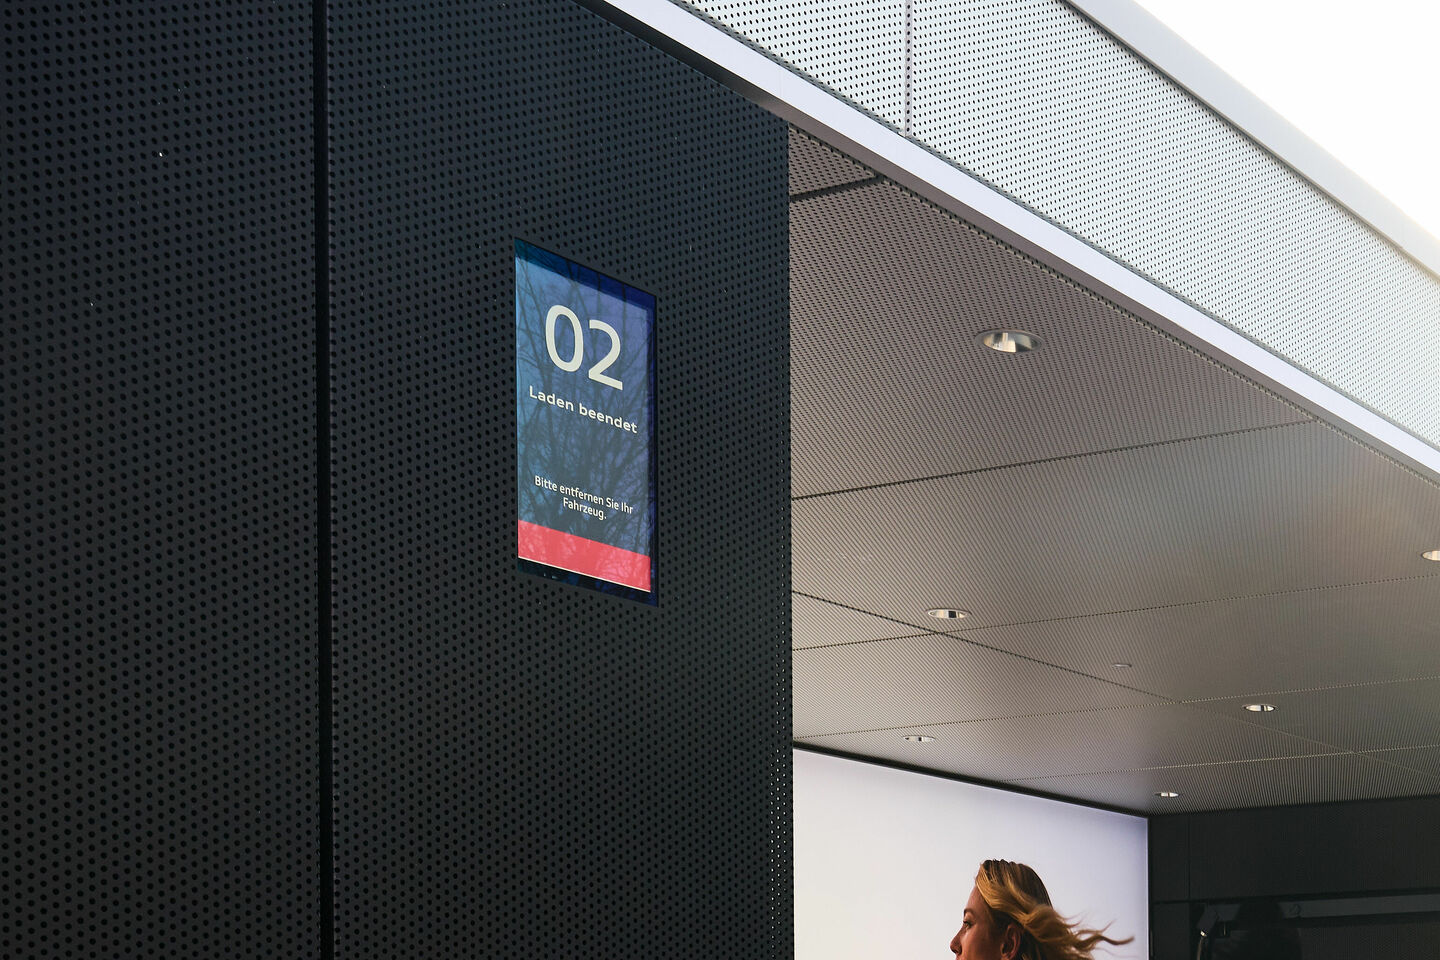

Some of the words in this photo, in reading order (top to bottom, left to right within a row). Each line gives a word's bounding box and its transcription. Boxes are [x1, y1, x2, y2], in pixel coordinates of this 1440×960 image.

[545, 304, 623, 391] 02
[529, 385, 574, 412] Laden
[579, 403, 637, 433] beendet
[534, 475, 558, 492] Bitte
[559, 485, 604, 505] entfernen
[606, 497, 619, 510] Sie
[621, 502, 634, 514] Ihr
[563, 497, 607, 521] Fahrzeug.
